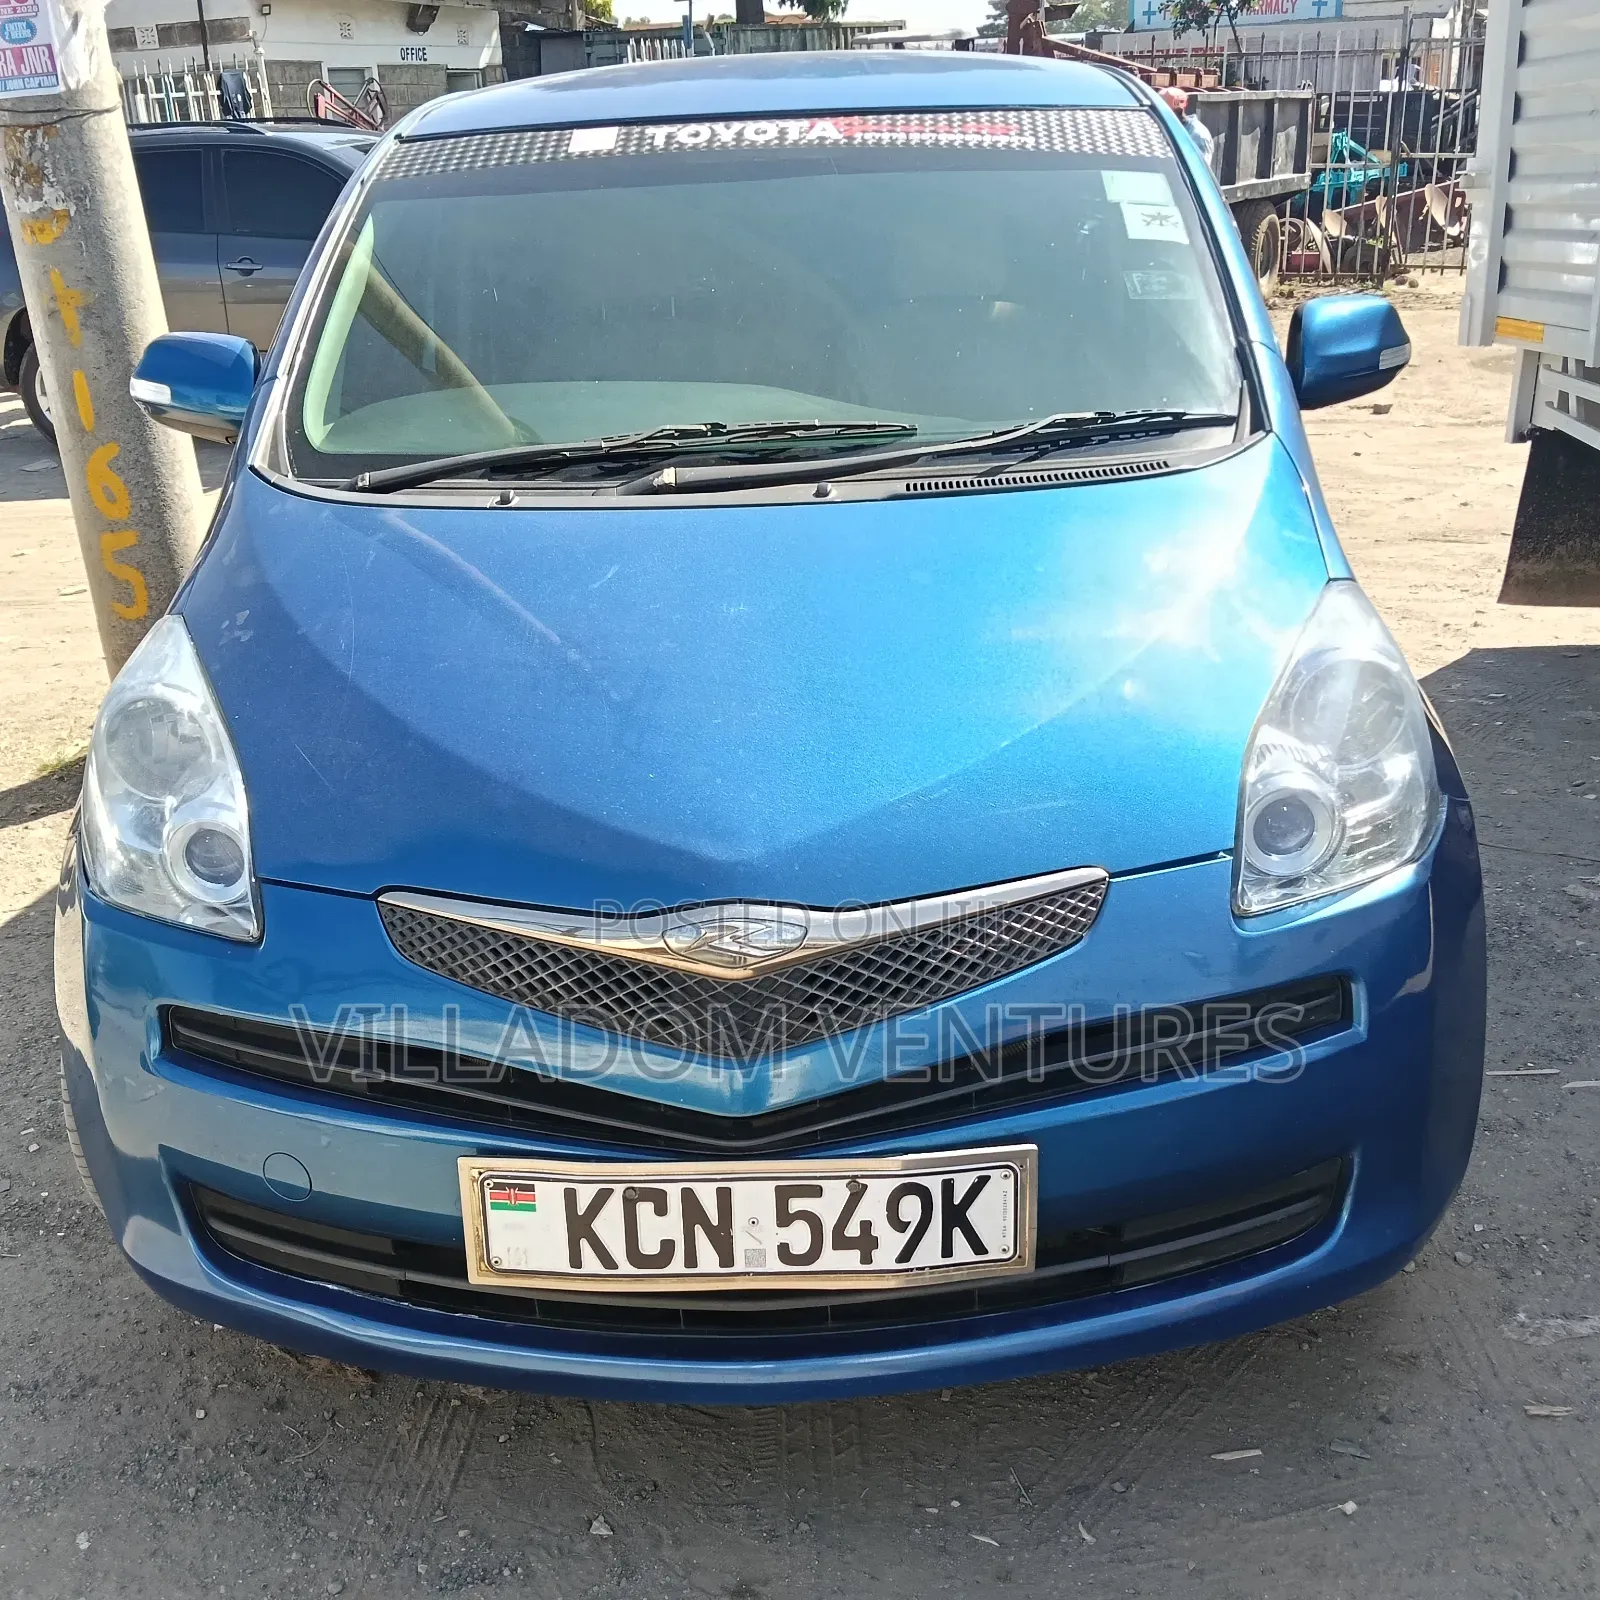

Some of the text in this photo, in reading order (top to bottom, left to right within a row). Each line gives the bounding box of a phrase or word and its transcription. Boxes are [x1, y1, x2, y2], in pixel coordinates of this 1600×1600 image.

[1233, 0, 1298, 16] RMACY
[21, 46, 53, 74] JNR
[400, 47, 427, 61] OFFICE
[24, 75, 57, 88] CAPTAIN
[645, 120, 843, 146] TOYOTA
[564, 1178, 993, 1271] KCN 549K
